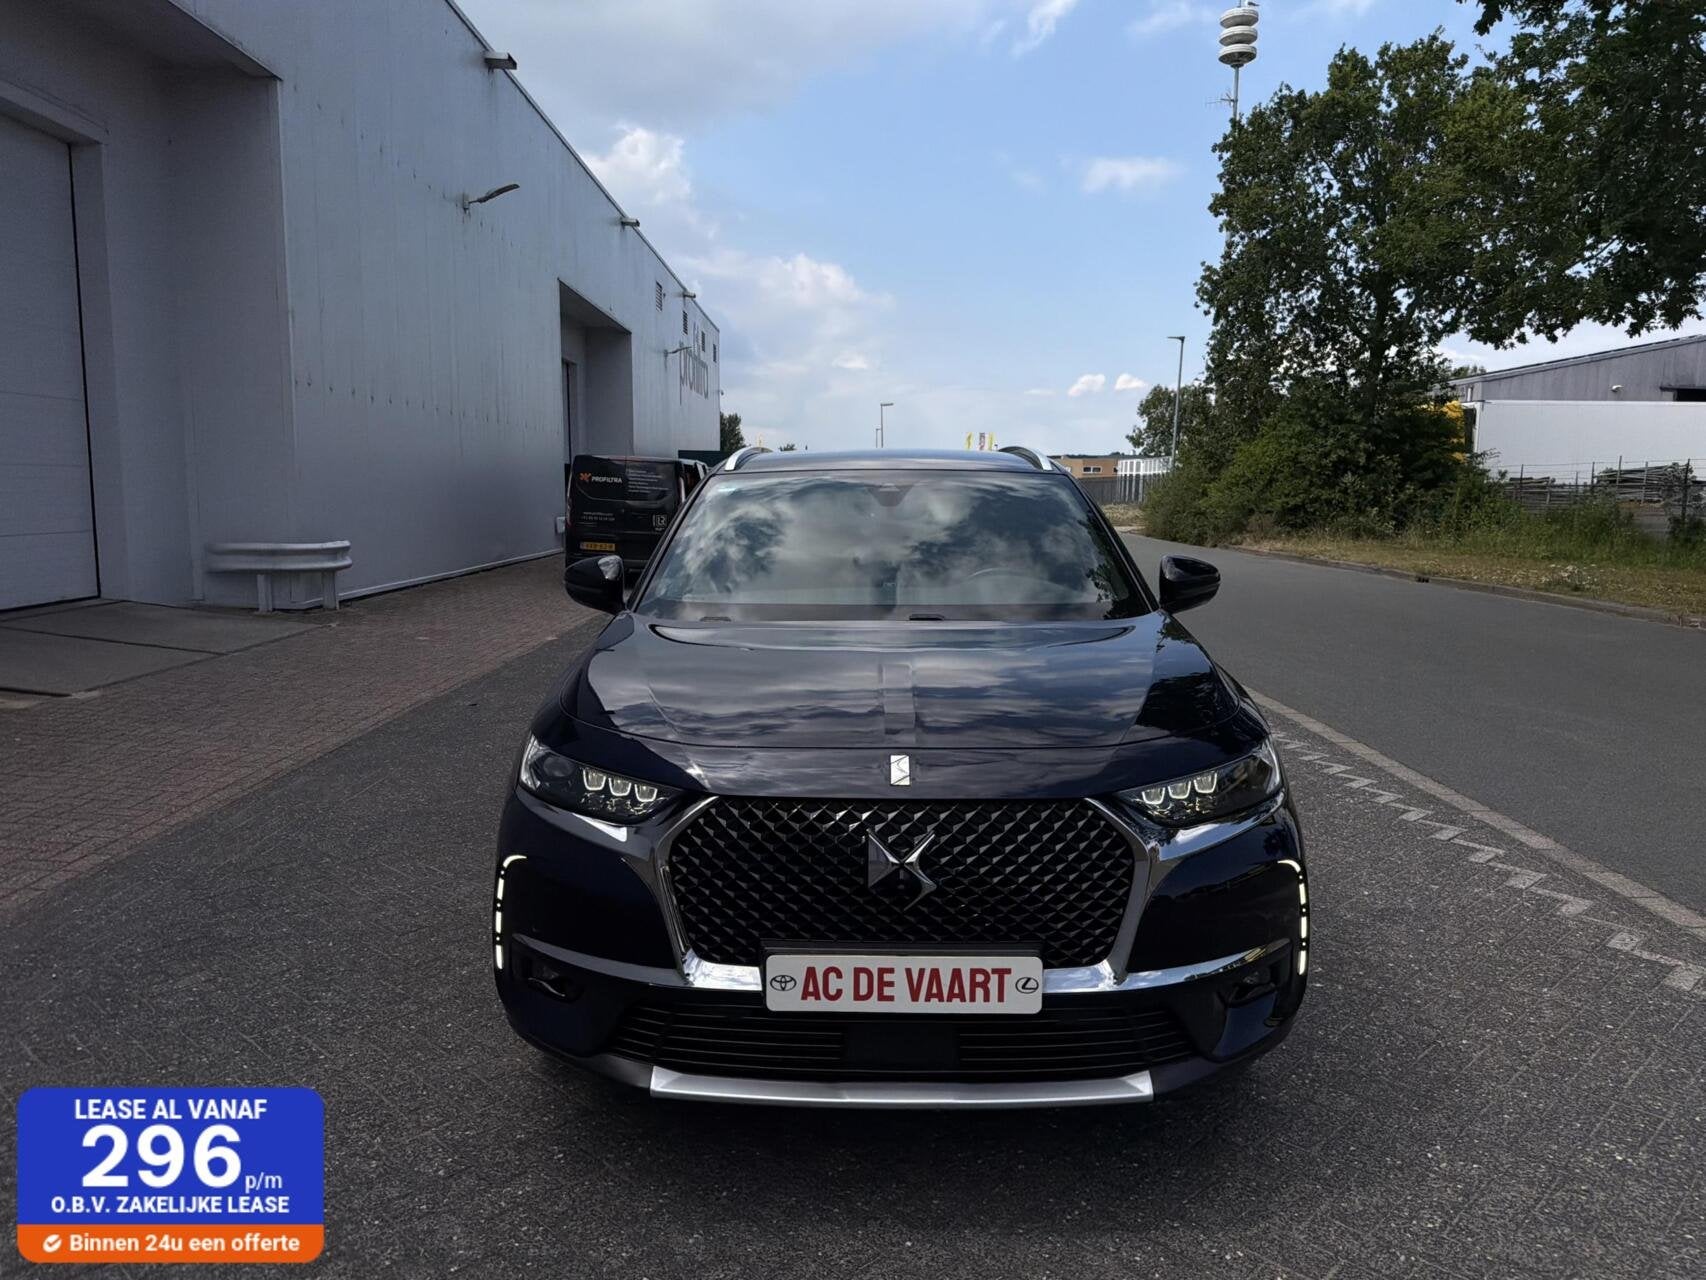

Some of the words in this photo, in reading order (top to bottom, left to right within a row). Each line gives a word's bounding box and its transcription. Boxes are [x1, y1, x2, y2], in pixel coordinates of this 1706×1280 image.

[801, 967, 843, 1001] AC
[853, 967, 895, 1001] DE
[905, 968, 1012, 1003] VAART
